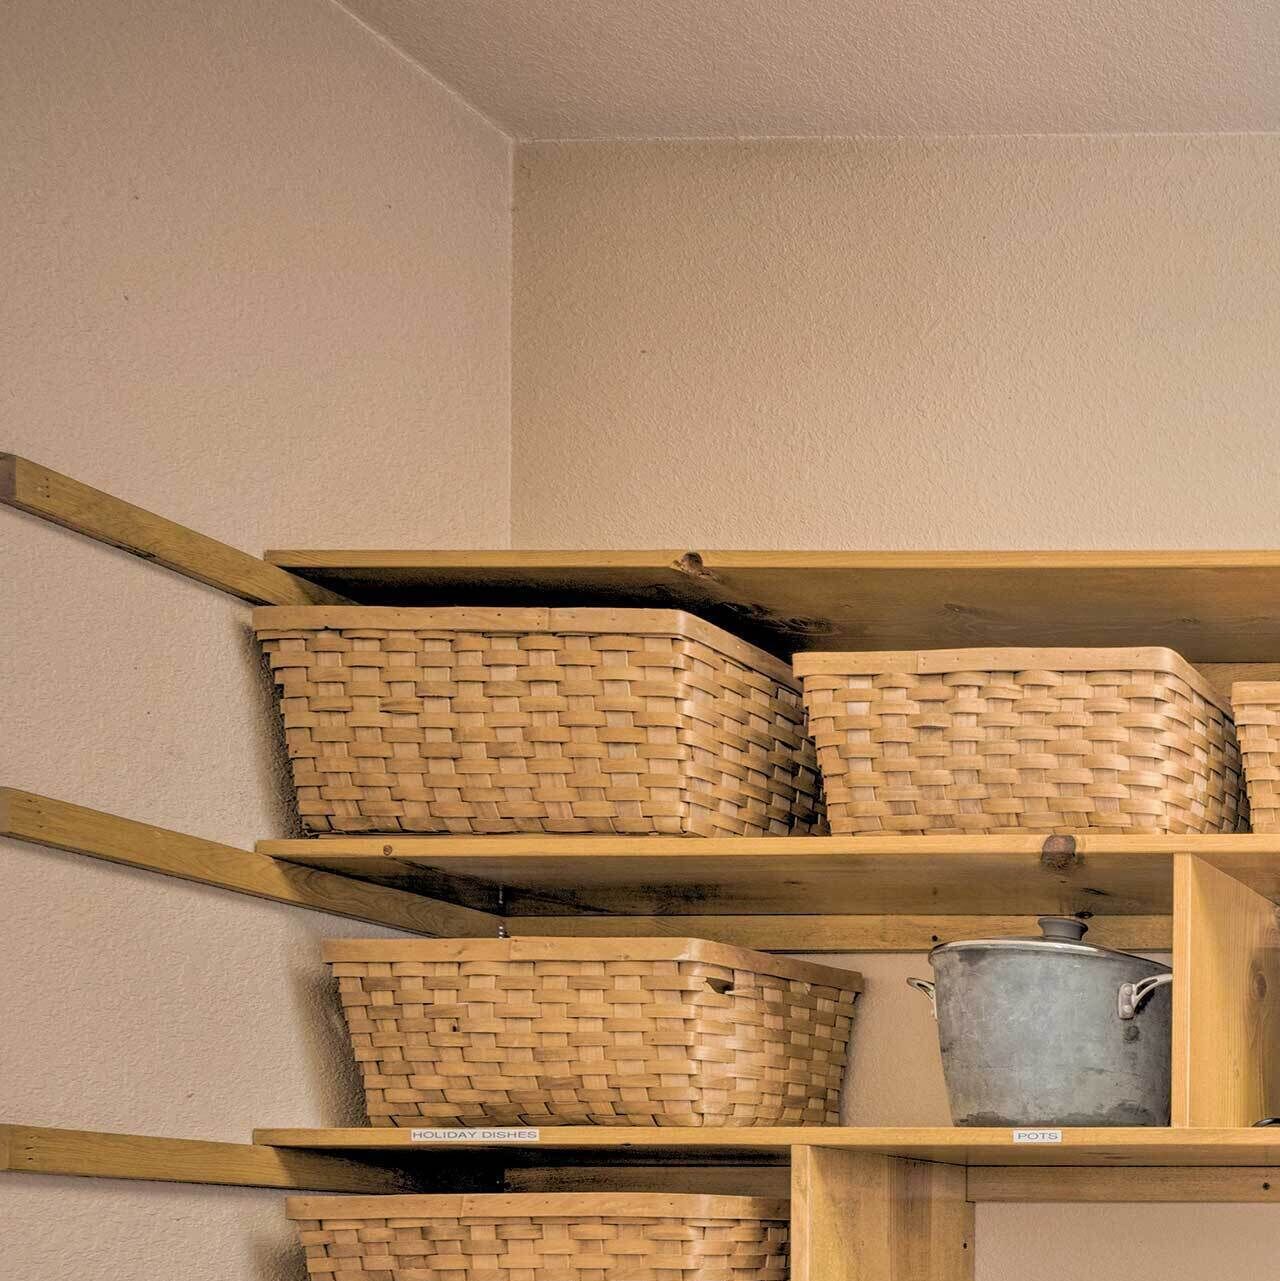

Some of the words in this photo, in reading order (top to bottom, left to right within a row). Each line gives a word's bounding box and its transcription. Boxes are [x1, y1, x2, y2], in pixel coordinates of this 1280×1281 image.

[412, 1130, 477, 1139] HOLIDAY
[481, 1130, 538, 1139] DISHES
[1017, 1131, 1059, 1140] POTS
